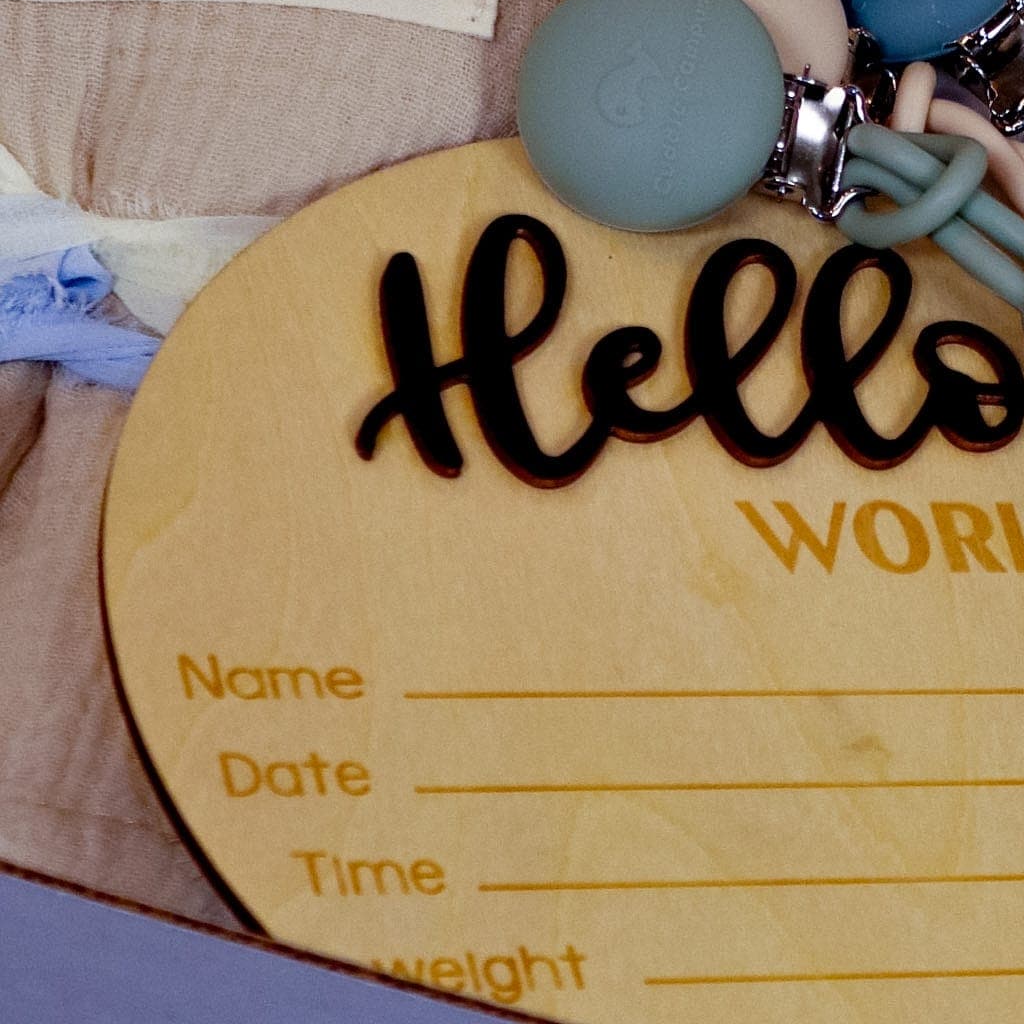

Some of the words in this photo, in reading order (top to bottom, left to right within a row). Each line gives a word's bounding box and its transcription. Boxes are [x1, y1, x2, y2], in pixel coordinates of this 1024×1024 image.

[176, 652, 366, 702] Name
[217, 750, 373, 798] Date
[289, 849, 447, 897] Time
